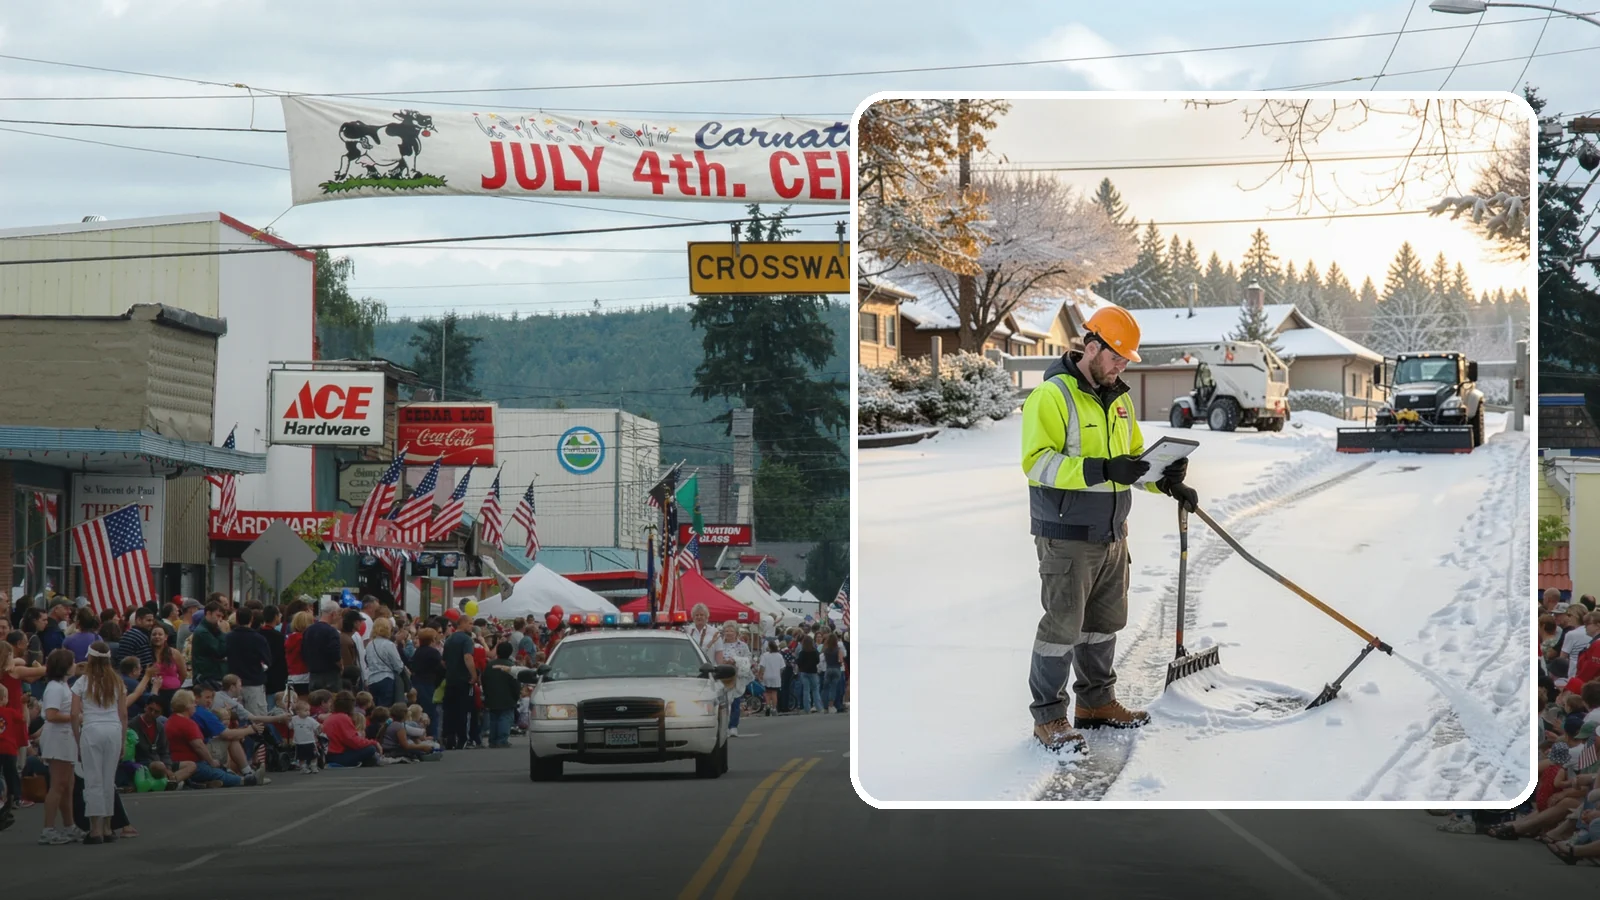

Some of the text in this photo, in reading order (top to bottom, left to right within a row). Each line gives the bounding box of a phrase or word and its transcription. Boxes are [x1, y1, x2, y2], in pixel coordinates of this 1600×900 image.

[481, 141, 605, 192] JULY
[632, 150, 746, 197] 4th.
[697, 254, 850, 280] CROSSWA
[283, 380, 373, 420] ACE
[405, 409, 485, 421] CEDAR LOG
[283, 421, 371, 437] Hardware
[416, 428, 476, 447] Coca-Cola
[95, 485, 124, 495] Vincent
[126, 485, 136, 495] de
[137, 486, 155, 496] Paul
[688, 526, 741, 535] CRNATION
[699, 535, 730, 543] GLASS
